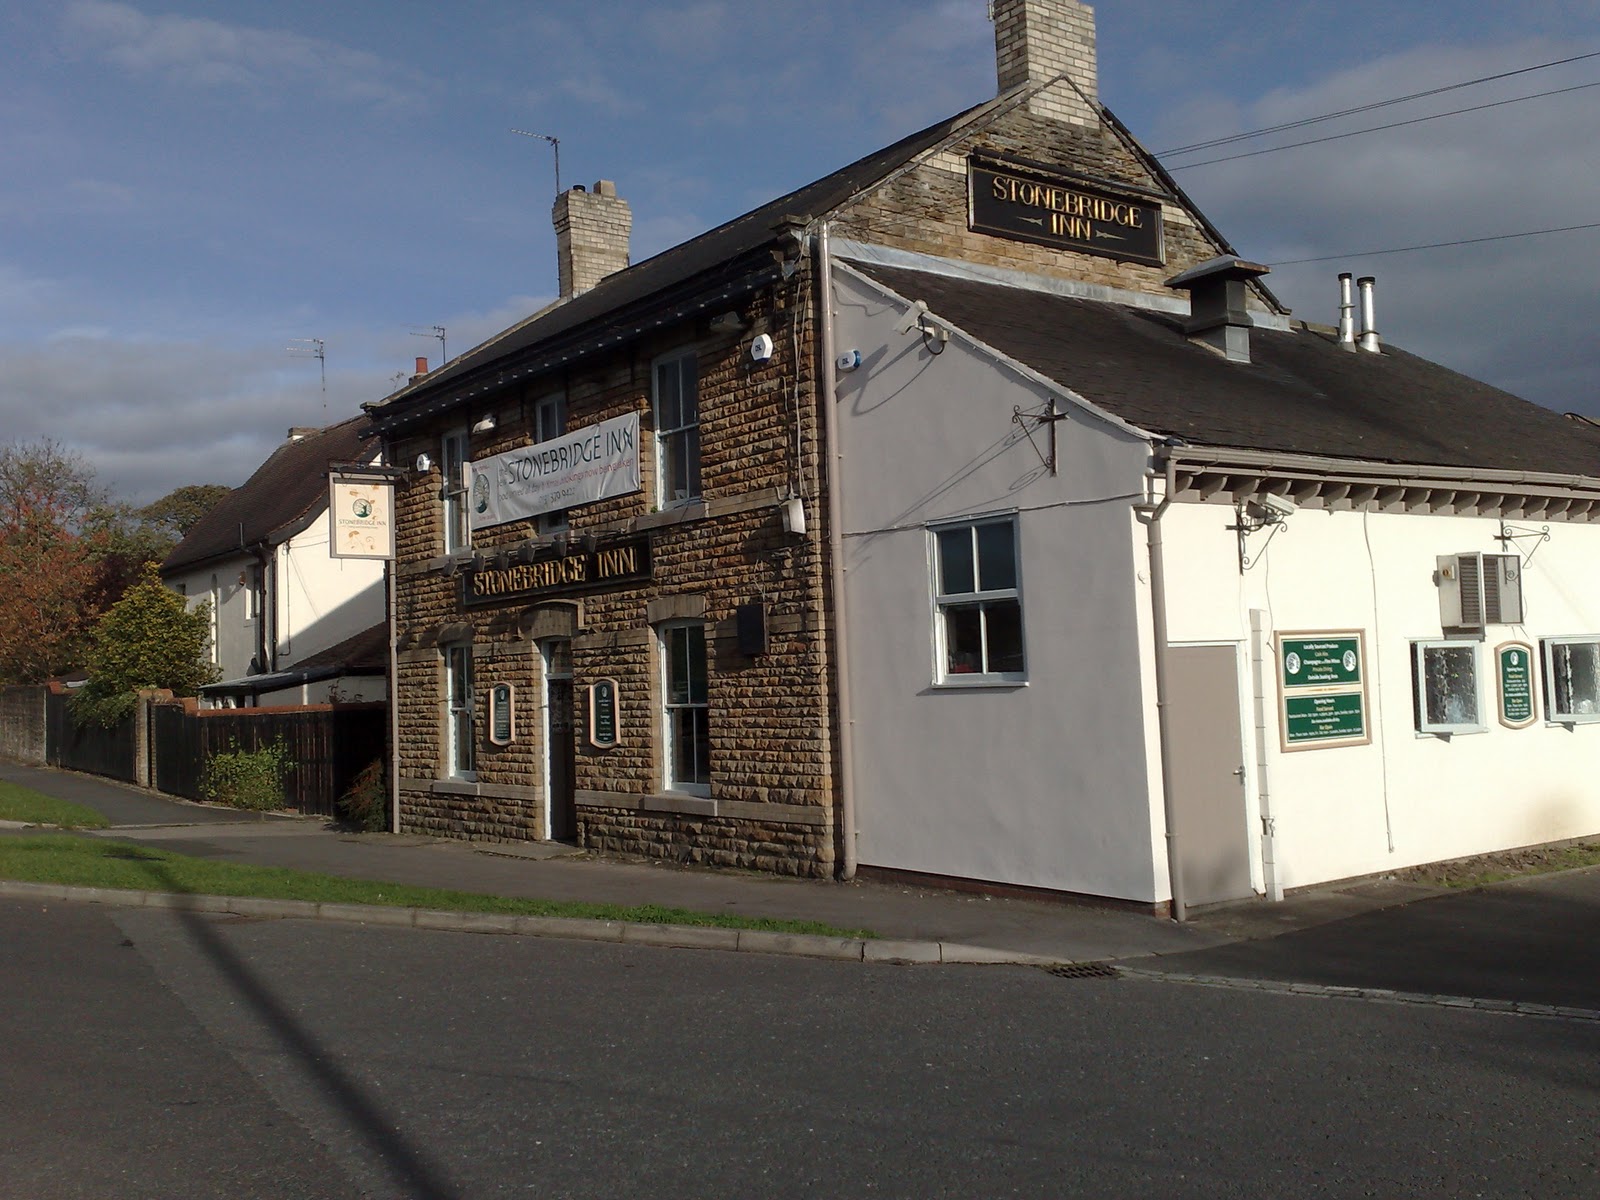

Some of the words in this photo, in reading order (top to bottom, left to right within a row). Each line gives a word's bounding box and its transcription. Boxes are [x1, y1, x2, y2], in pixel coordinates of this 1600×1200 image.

[993, 176, 1143, 229] STONEBRIDGE
[1051, 213, 1091, 240] INN
[508, 435, 601, 484] STONEBRIDGE
[606, 428, 633, 456] INN
[473, 555, 585, 596] STONEBRIDGE
[598, 547, 637, 578] INN
